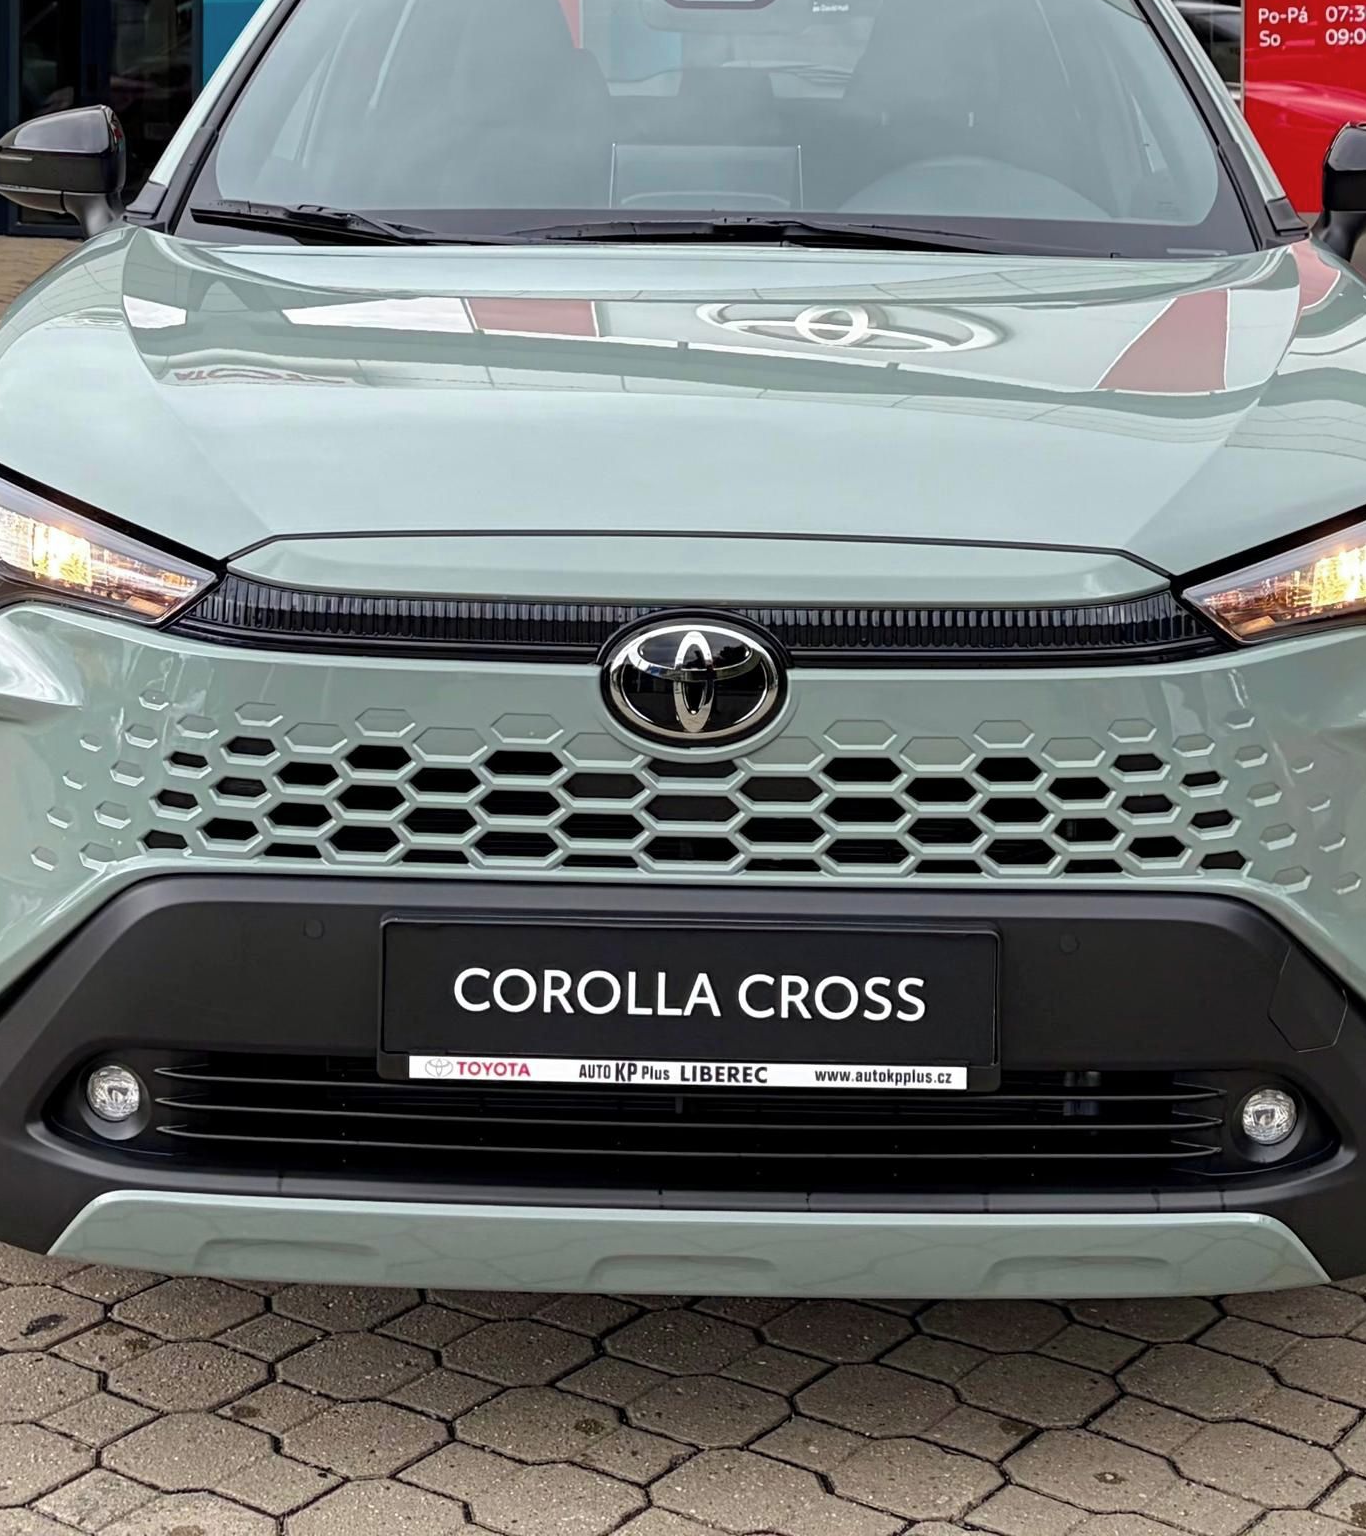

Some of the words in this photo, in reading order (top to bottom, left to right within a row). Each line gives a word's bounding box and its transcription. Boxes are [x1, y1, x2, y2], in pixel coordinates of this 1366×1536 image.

[1258, 6, 1308, 24] Po-Pá
[1259, 30, 1281, 47] So
[453, 967, 721, 1017] COROLLA
[737, 973, 926, 1023] CROSS
[456, 1060, 531, 1077] TOYOTA
[579, 1064, 611, 1079] AUTO
[615, 1062, 637, 1082] KP
[641, 1065, 670, 1081] Plus
[679, 1065, 769, 1083] LIBEREC
[814, 1069, 953, 1086] www.autokpplus.cz
